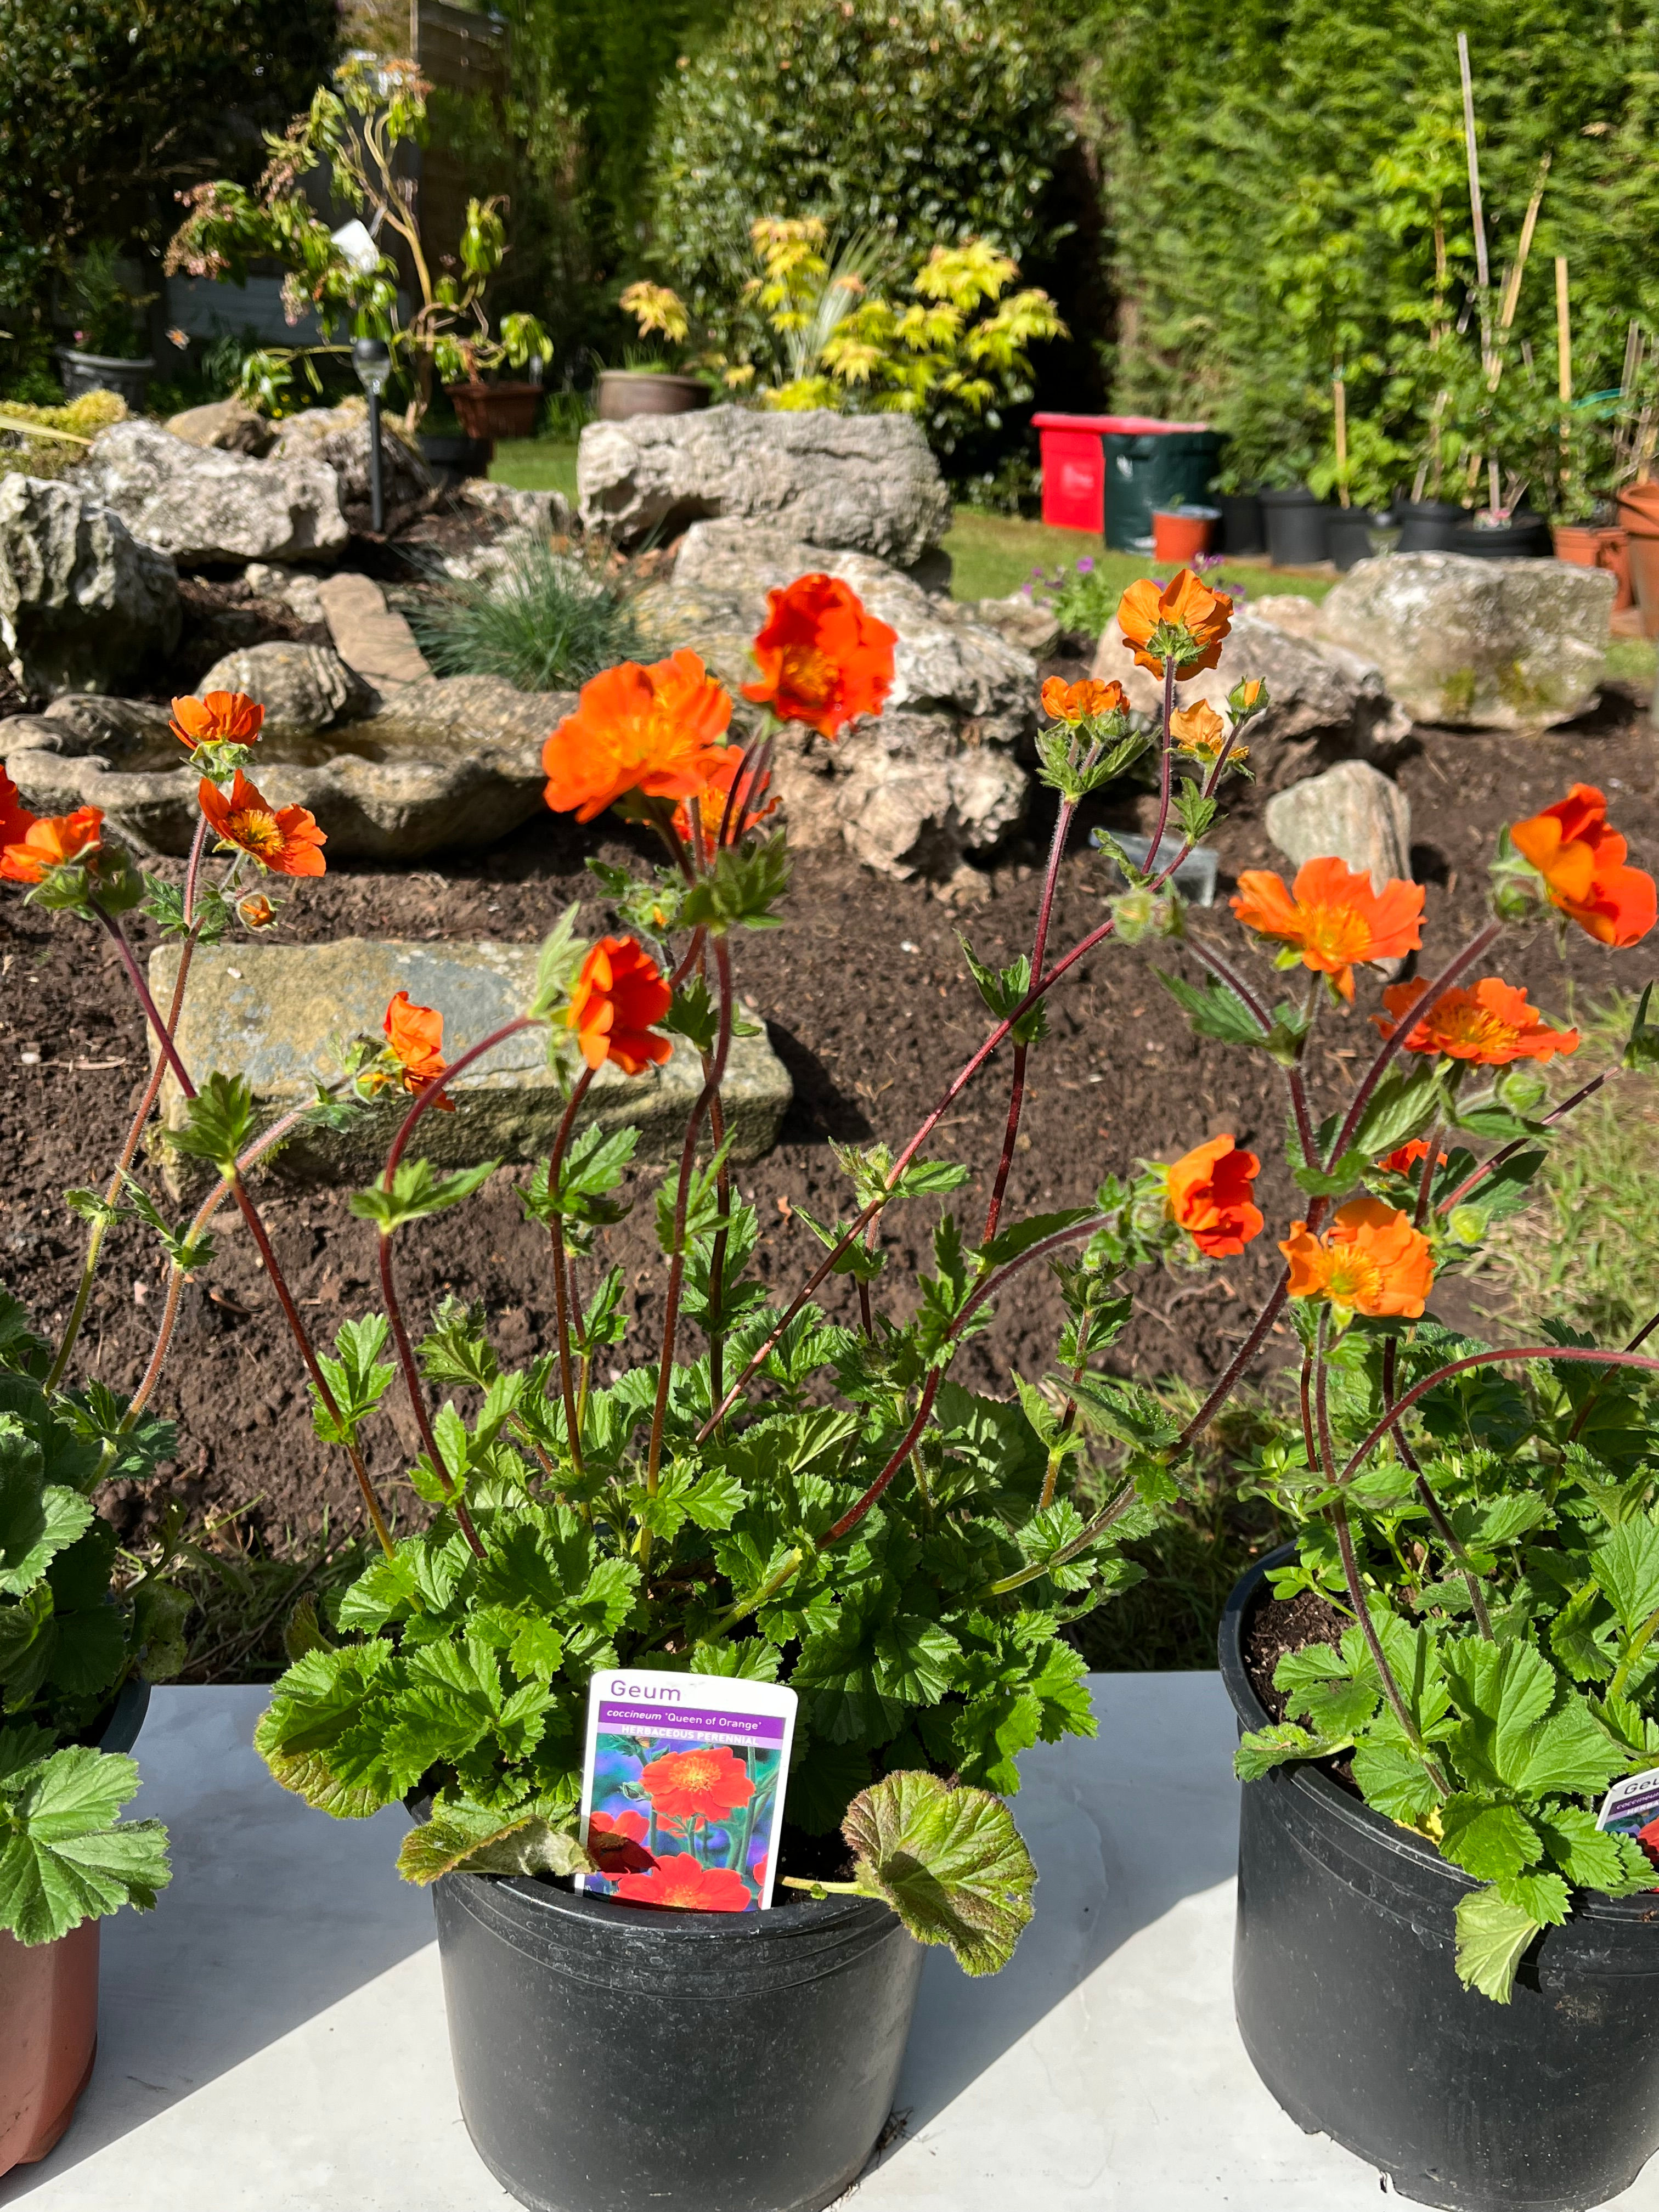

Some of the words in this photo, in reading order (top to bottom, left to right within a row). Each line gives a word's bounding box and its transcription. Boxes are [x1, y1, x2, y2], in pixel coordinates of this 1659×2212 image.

[611, 1680, 681, 1701] Geum
[607, 1710, 662, 1720] coccineum
[705, 1717, 716, 1725] of
[622, 1725, 695, 1739] HERBACEOUS
[697, 1732, 759, 1746] PERENNIAL
